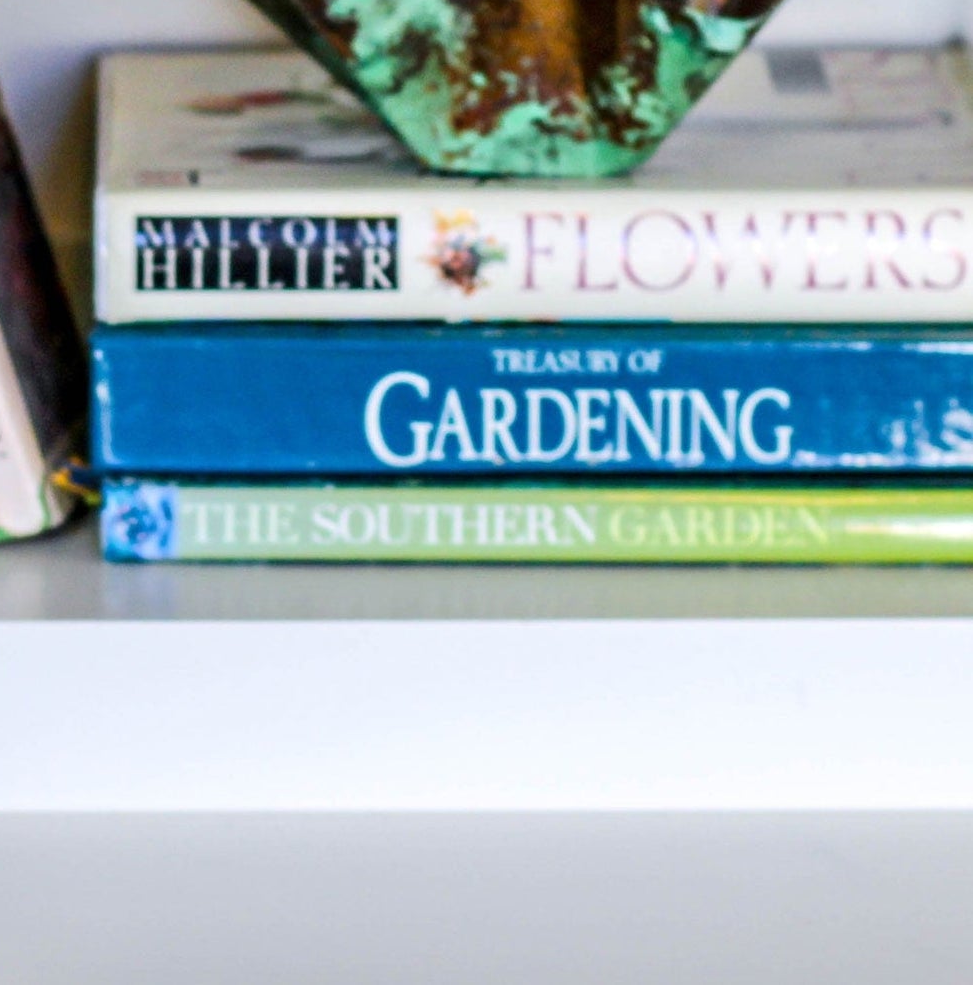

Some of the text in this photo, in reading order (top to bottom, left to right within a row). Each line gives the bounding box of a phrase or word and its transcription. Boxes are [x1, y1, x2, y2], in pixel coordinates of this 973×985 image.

[140, 218, 393, 248] MALCOLM
[519, 207, 969, 293] FLOWERS
[141, 248, 393, 290] HILLIER
[492, 349, 667, 375] TREASURY OF
[363, 370, 795, 467] GARDENING
[183, 502, 831, 548] THE SOUTHERN GARDEN
